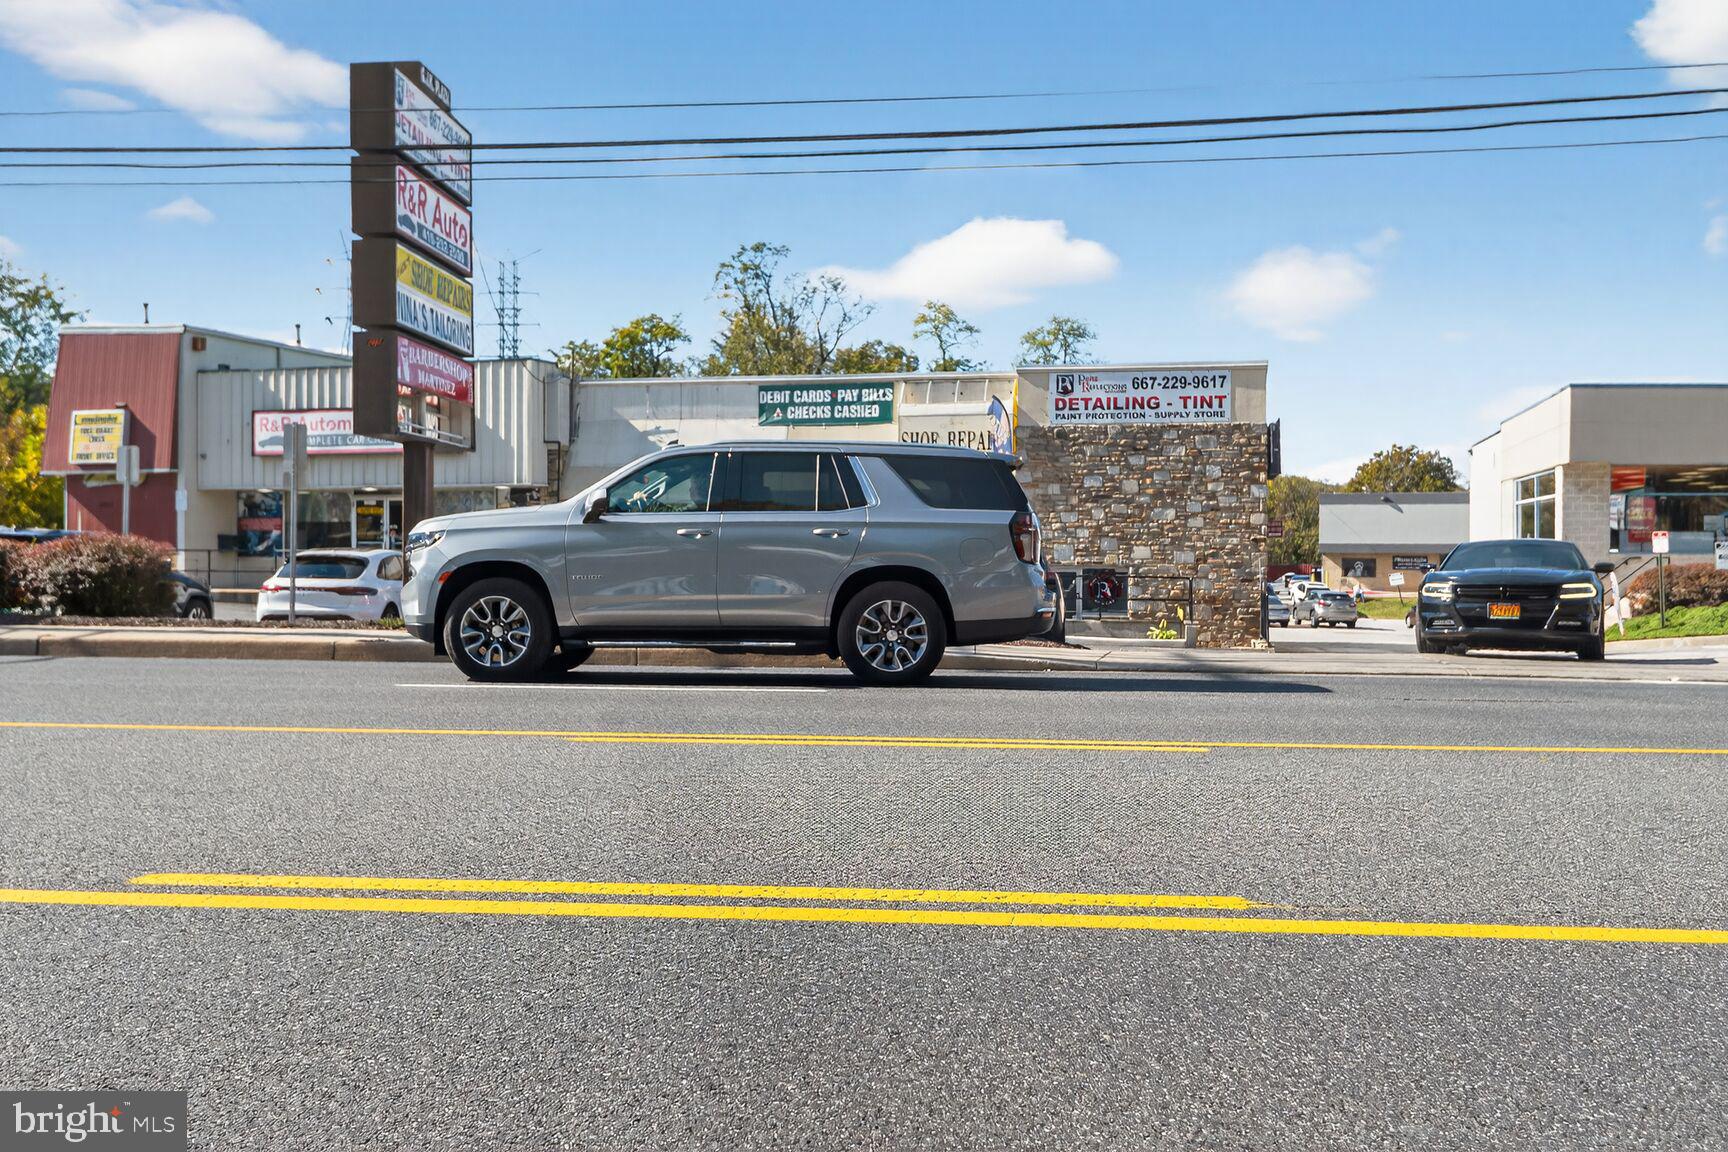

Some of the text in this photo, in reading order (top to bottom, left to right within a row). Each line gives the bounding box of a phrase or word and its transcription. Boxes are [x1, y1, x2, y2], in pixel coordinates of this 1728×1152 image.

[397, 167, 428, 224] R&R
[431, 197, 468, 248] Auto
[397, 290, 471, 351] NINA'S TAILORING
[409, 346, 468, 387] BARBERSHOP
[417, 369, 456, 396] MARTINEZ
[1132, 375, 1227, 390] 667-229-9617
[759, 388, 893, 404] DEBIT CARDS PAY BILLS
[1055, 396, 1160, 411] DETAILING
[1179, 395, 1227, 409] TINT
[787, 404, 880, 419] CHECKS CASHED
[1055, 412, 1082, 420] PAINT
[1085, 412, 1146, 420] PROTECTION
[1154, 411, 1191, 419] SUPPLY
[1194, 411, 1226, 419] STORE
[346, 435, 366, 445] CAR
